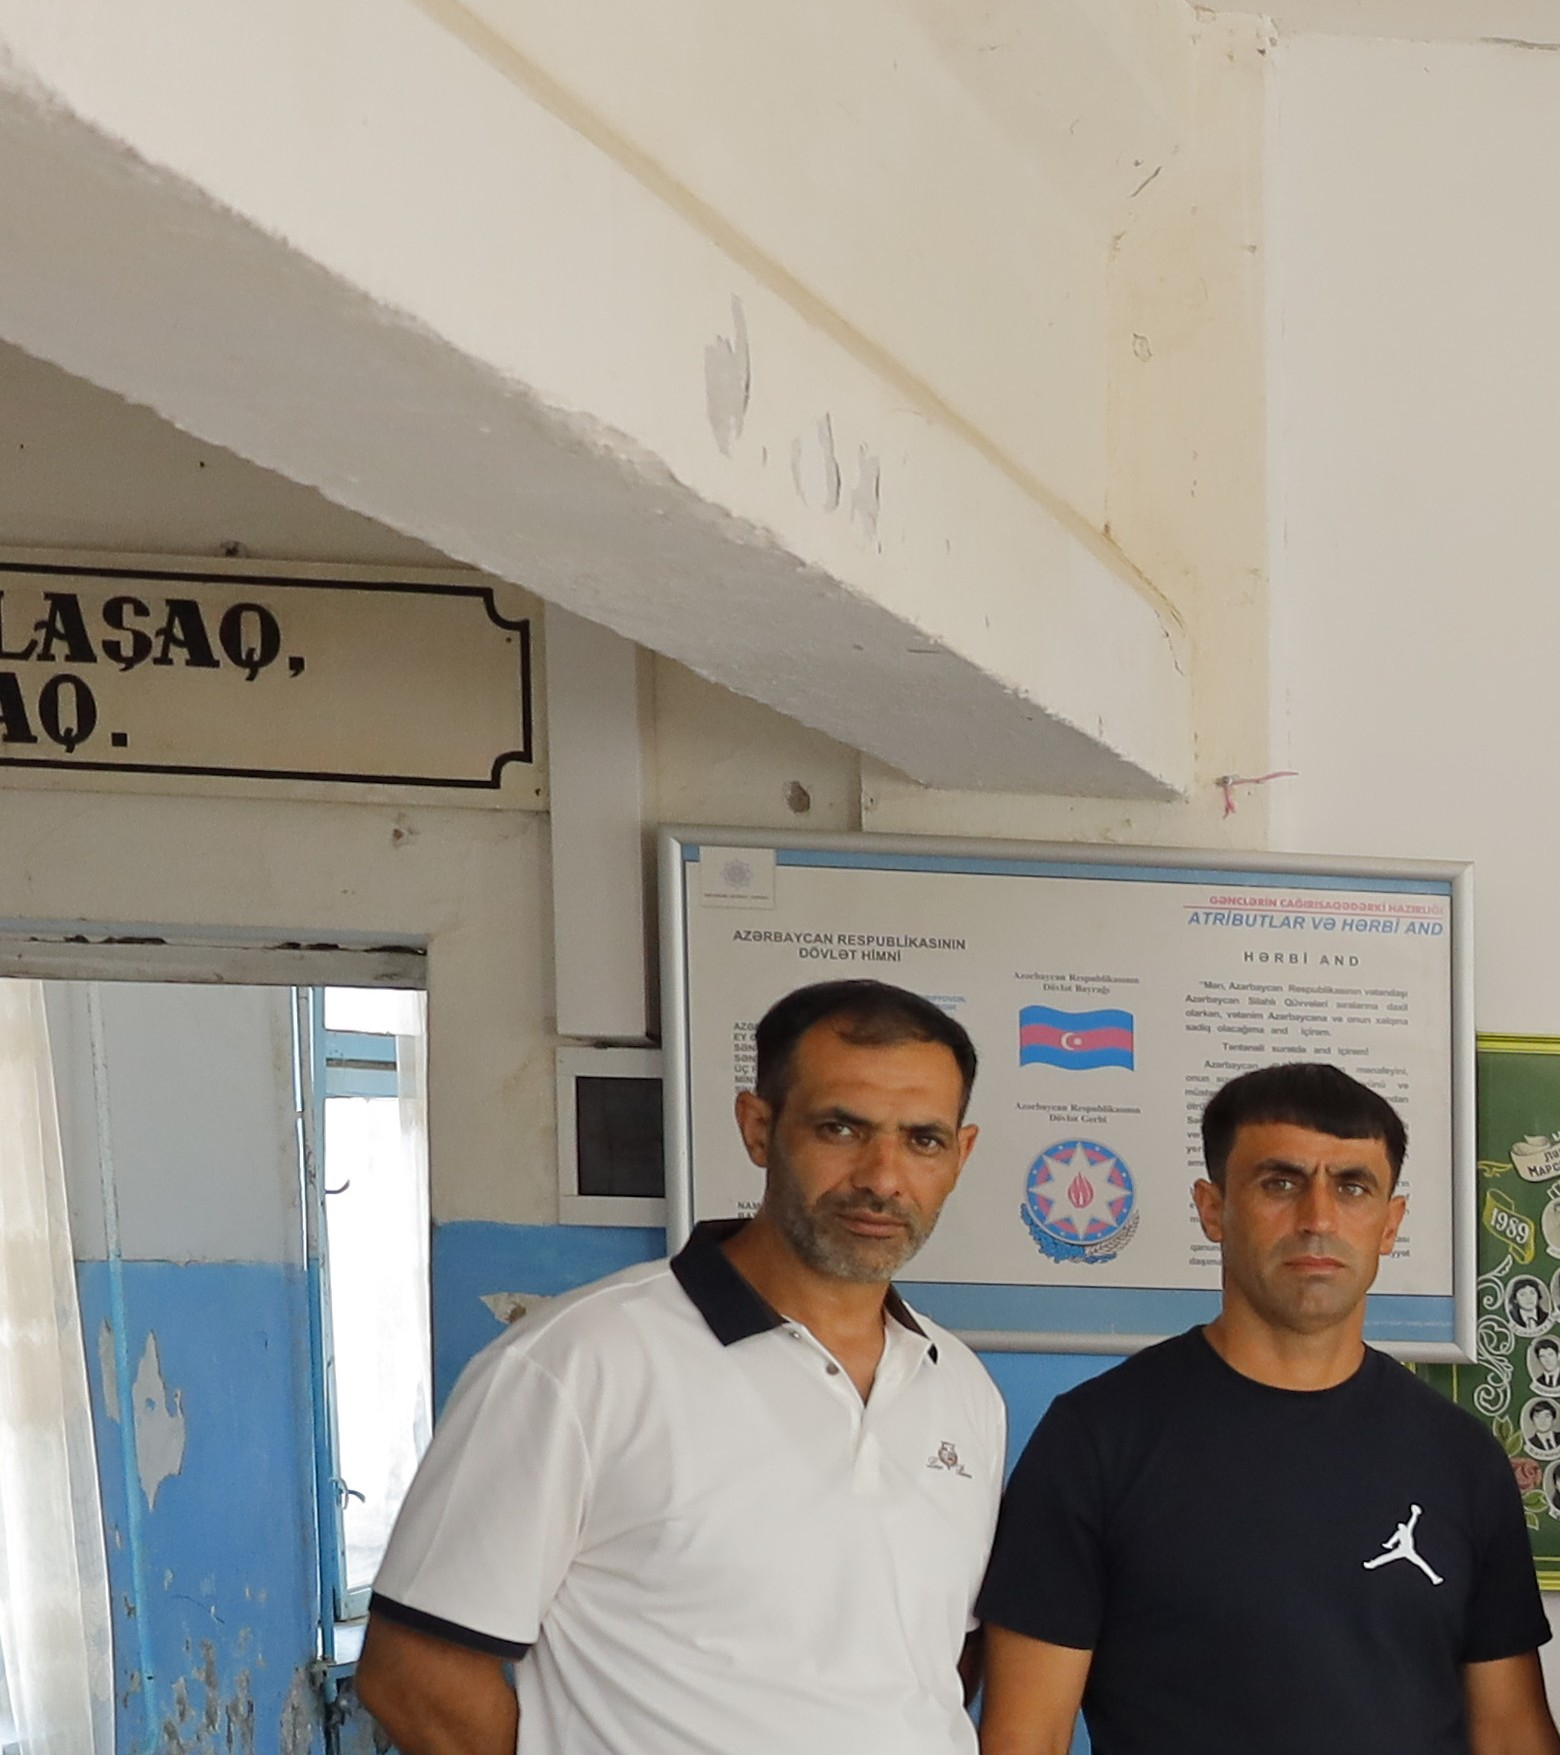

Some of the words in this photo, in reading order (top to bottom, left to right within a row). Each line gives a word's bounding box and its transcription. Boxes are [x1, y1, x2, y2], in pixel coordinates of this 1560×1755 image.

[1188, 910, 1305, 930] ATRİBUTLAR
[1312, 917, 1336, 931] VƏ
[1341, 917, 1400, 934] HƏRBİ
[1404, 921, 1443, 936] AND
[733, 930, 833, 945] AZƏRBAYCAN
[837, 934, 967, 950] RESPUBLİKASININ
[799, 947, 857, 961] DÖVLƏT
[861, 949, 901, 962] HİMNİ
[1319, 954, 1360, 967] AND
[1490, 1207, 1529, 1244] 1989
